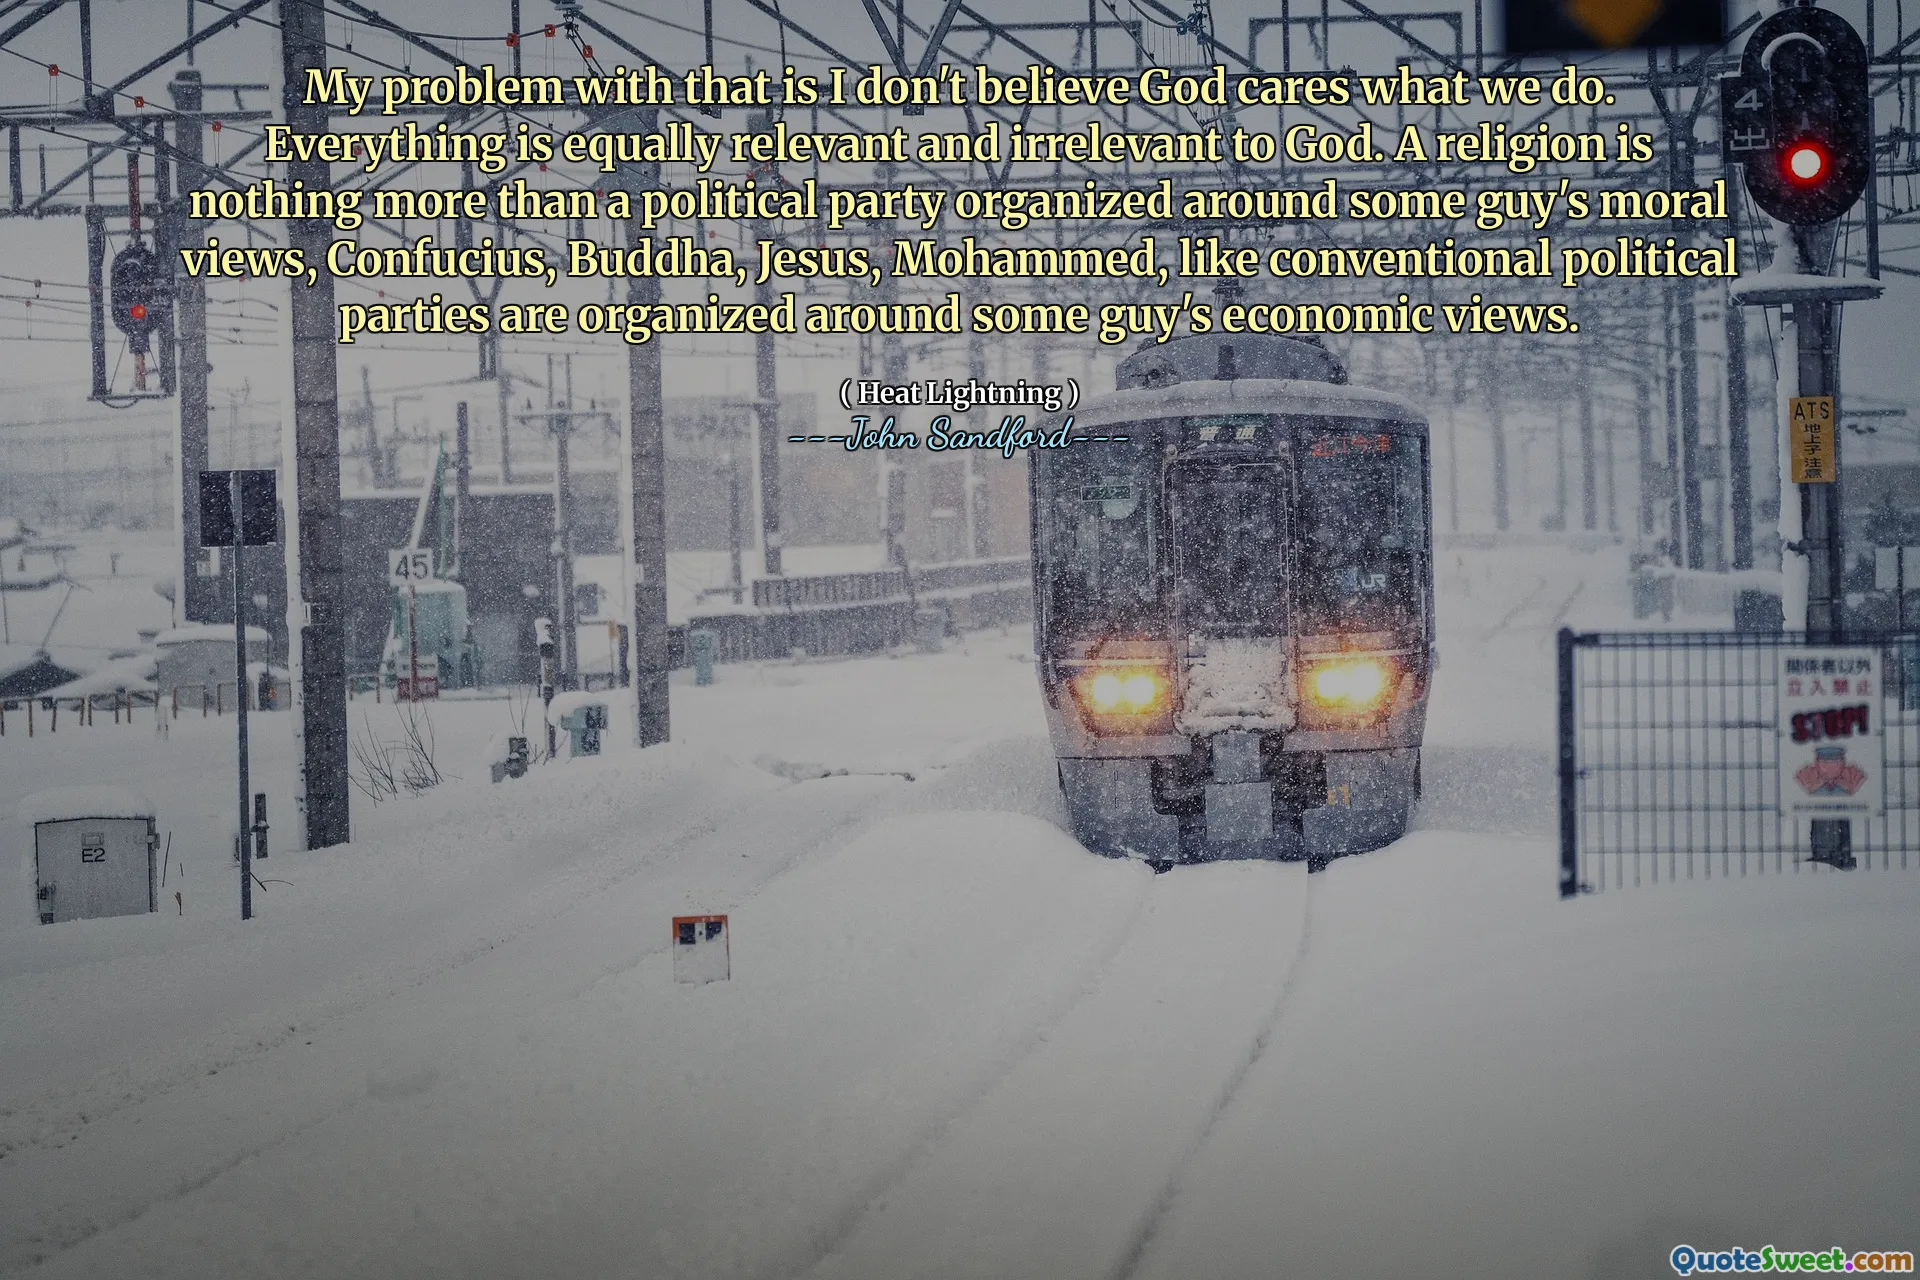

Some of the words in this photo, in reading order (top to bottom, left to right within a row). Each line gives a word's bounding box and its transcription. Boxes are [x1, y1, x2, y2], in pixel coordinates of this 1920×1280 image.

[1794, 401, 1830, 420] ATS
[395, 553, 428, 580] 45
[1361, 574, 1386, 588] JR
[1786, 677, 1872, 697] 立入禁止
[82, 847, 106, 863] E2
